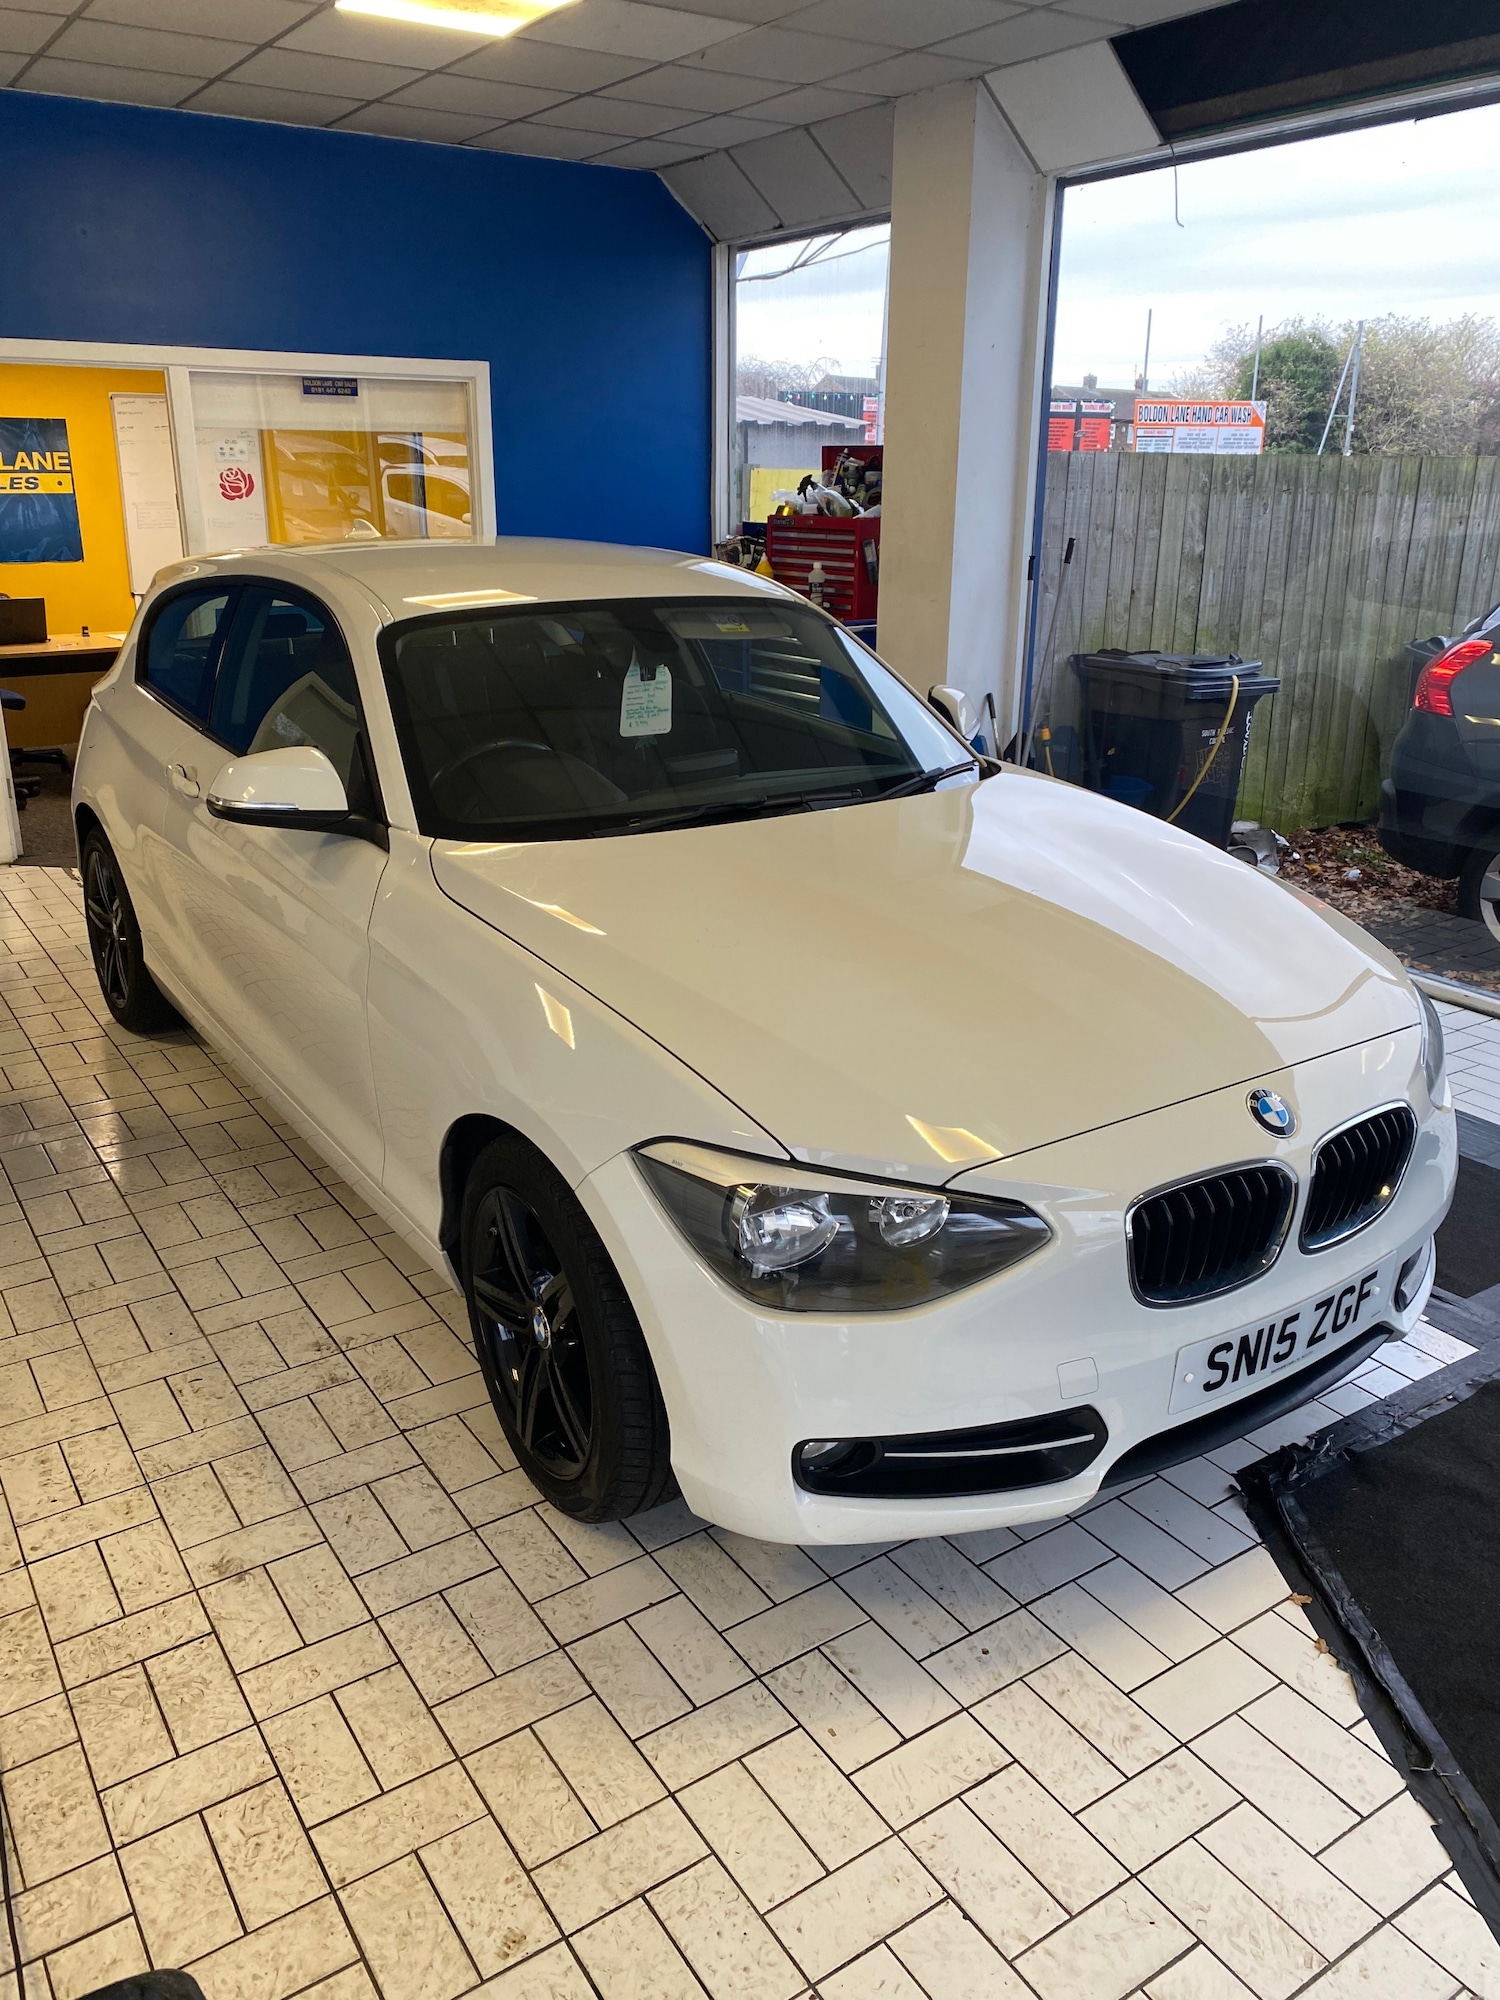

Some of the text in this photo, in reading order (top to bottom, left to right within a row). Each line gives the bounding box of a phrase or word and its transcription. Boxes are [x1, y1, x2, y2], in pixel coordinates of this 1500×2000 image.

[1138, 405, 1169, 422] BOLDON
[1170, 406, 1190, 422] LANE
[1192, 406, 1213, 423] HAND
[1214, 407, 1229, 423] CAR
[1230, 407, 1252, 423] WASH
[0, 451, 71, 471] LANE
[1249, 1089, 1281, 1108] BMW
[1203, 1270, 1379, 1392] SN15 ZGF
